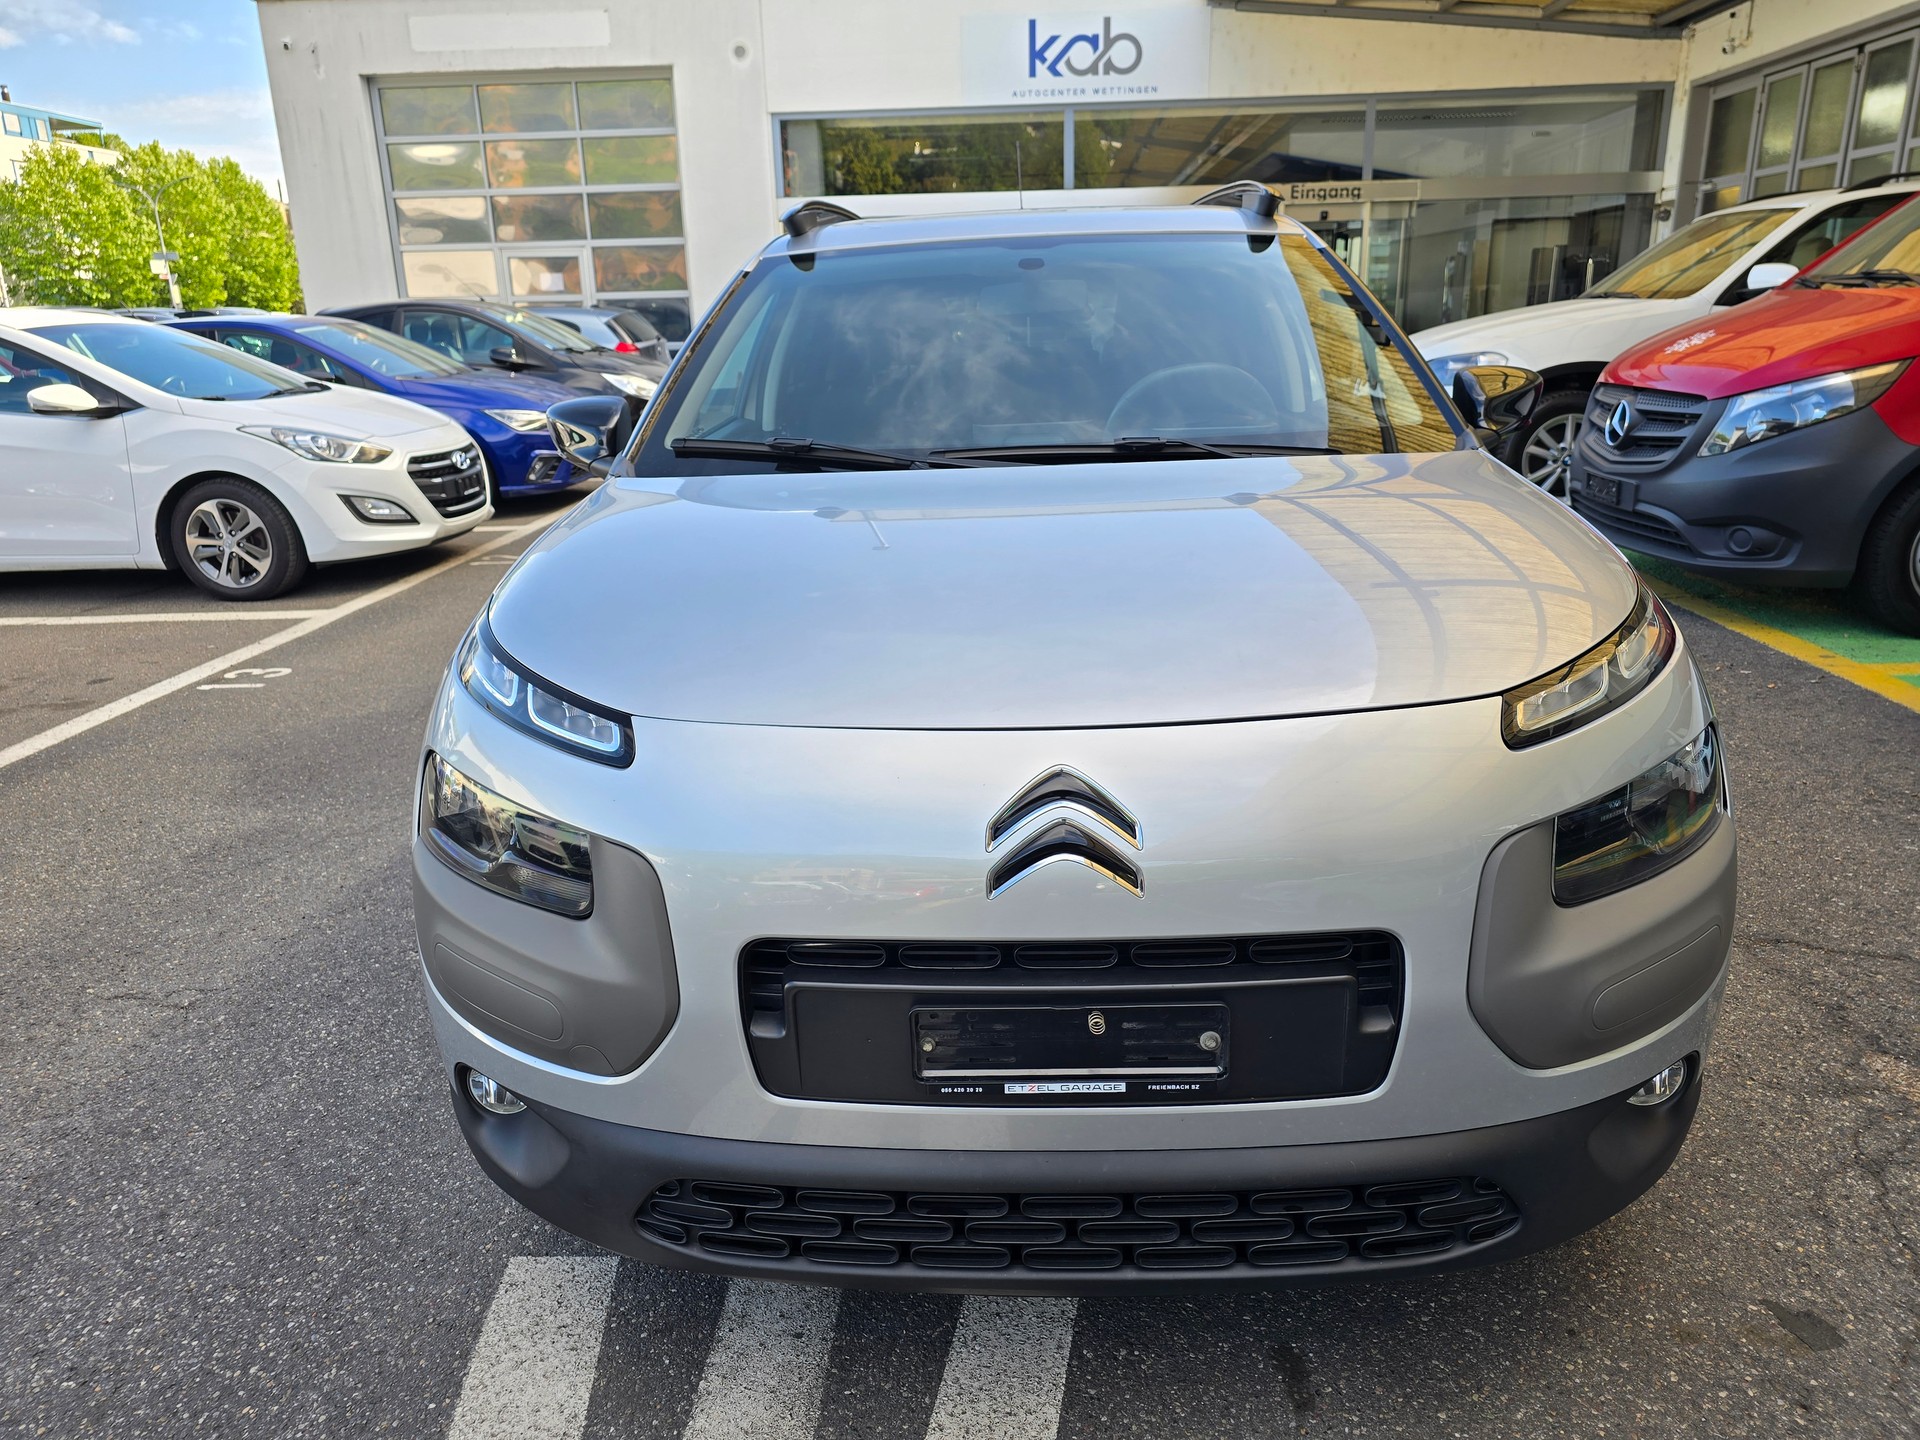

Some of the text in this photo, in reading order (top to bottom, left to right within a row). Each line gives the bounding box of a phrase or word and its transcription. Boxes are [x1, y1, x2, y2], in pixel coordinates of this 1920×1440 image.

[1028, 16, 1143, 78] kab
[1012, 85, 1158, 98] AUTOCENTER WETTINGEN
[1291, 184, 1362, 201] Eingang
